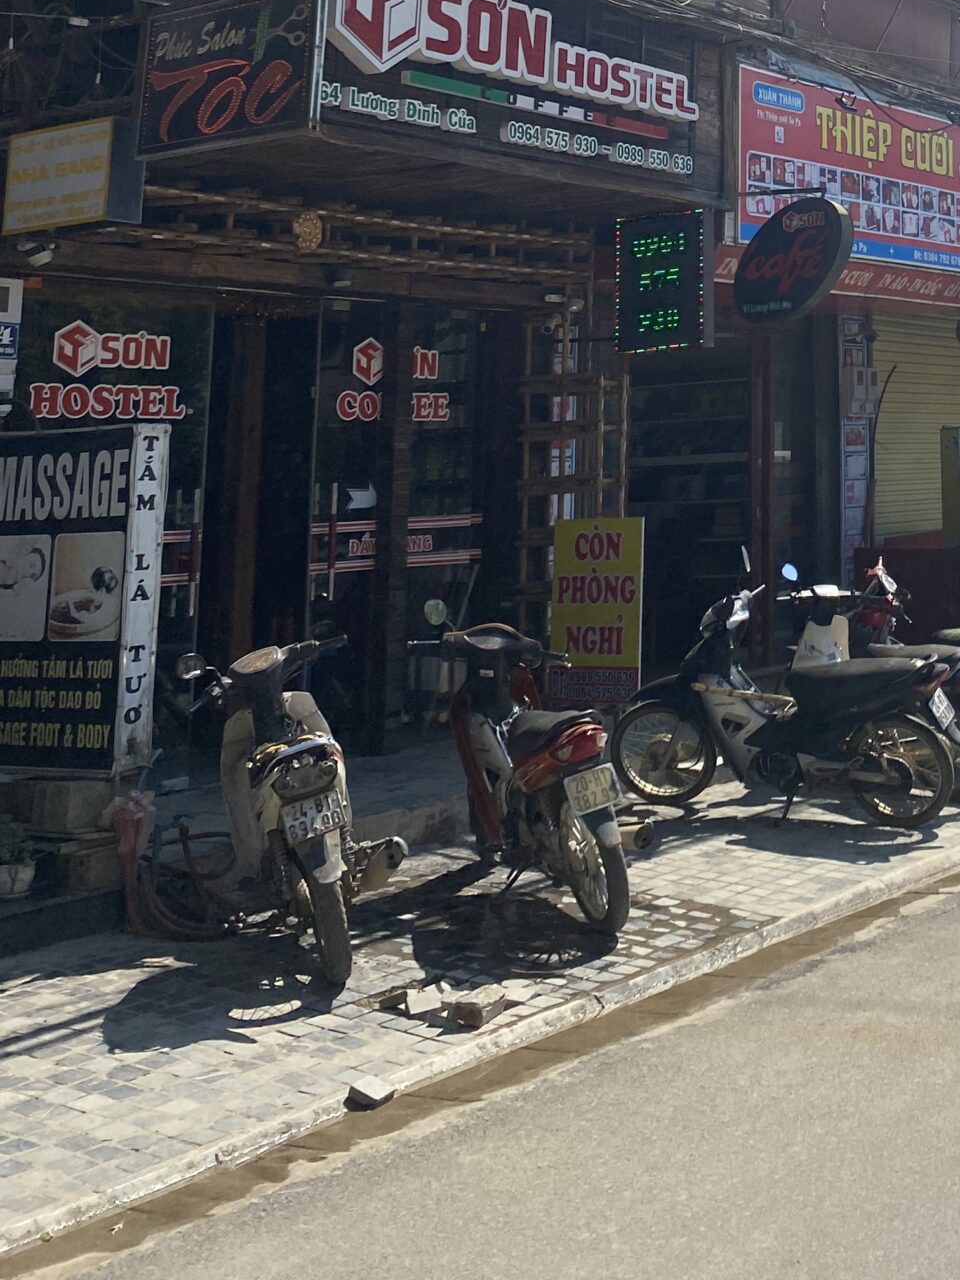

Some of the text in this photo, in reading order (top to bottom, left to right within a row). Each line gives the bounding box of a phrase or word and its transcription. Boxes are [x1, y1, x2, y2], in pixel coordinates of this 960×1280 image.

[197, 21, 247, 55] Salon
[556, 46, 698, 117] HOSTEL
[320, 84, 476, 131] 64 Lương Đình Của
[508, 121, 540, 144] 0964
[545, 128, 569, 150] 575
[574, 135, 598, 156] 930
[616, 143, 644, 166] 0989
[649, 149, 669, 169] 550
[673, 152, 693, 174] 636
[815, 105, 892, 170] THIỆP
[900, 126, 955, 178] CƯỚI
[101, 330, 170, 371] SƠN
[30, 382, 186, 420] HOSTEL
[574, 524, 623, 561] CÒN
[557, 567, 637, 605] PHÒNG
[69, 656, 84, 679] LÁ
[87, 658, 114, 679] TƯƠI
[30, 722, 61, 748] FOOT
[64, 723, 73, 748] &
[77, 723, 111, 749] BODY
